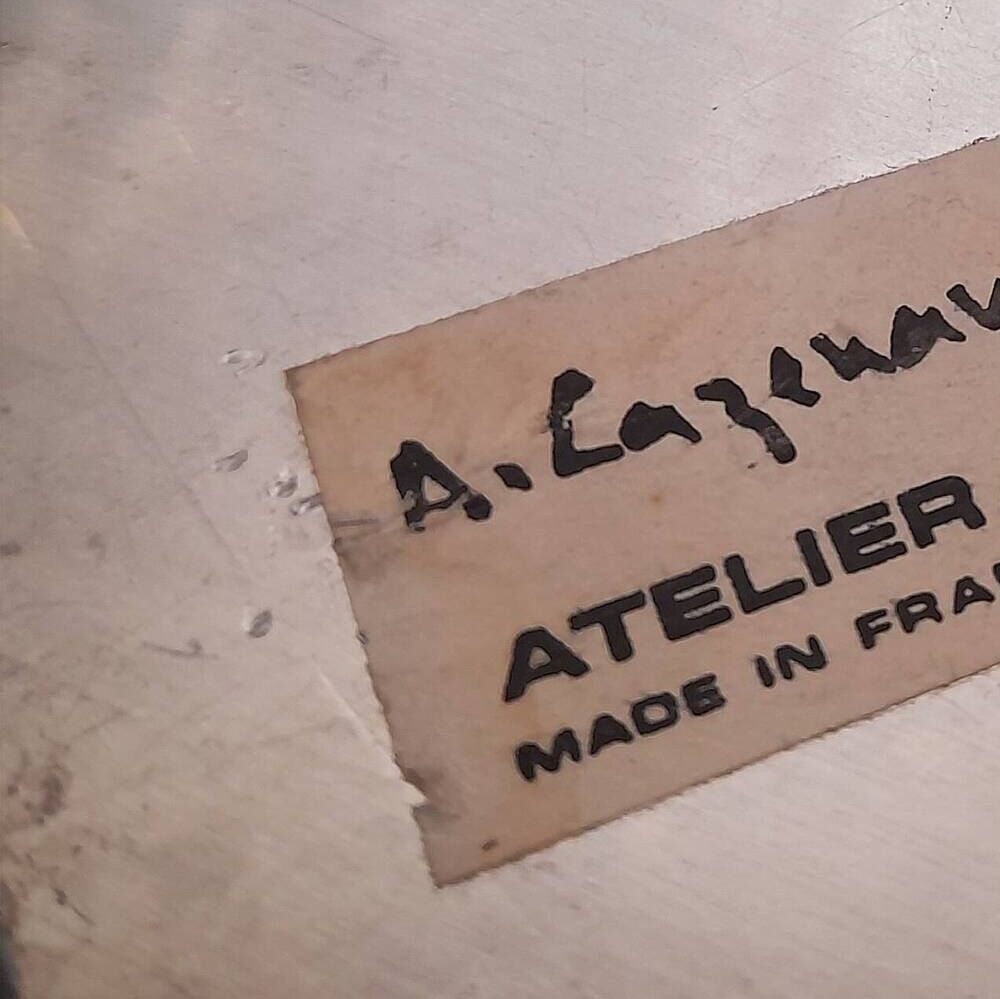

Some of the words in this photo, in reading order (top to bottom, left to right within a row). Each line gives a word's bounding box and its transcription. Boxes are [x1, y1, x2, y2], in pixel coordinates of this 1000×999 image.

[500, 474, 988, 705] ATELIER
[512, 672, 728, 785] MADE
[752, 633, 829, 690] IN
